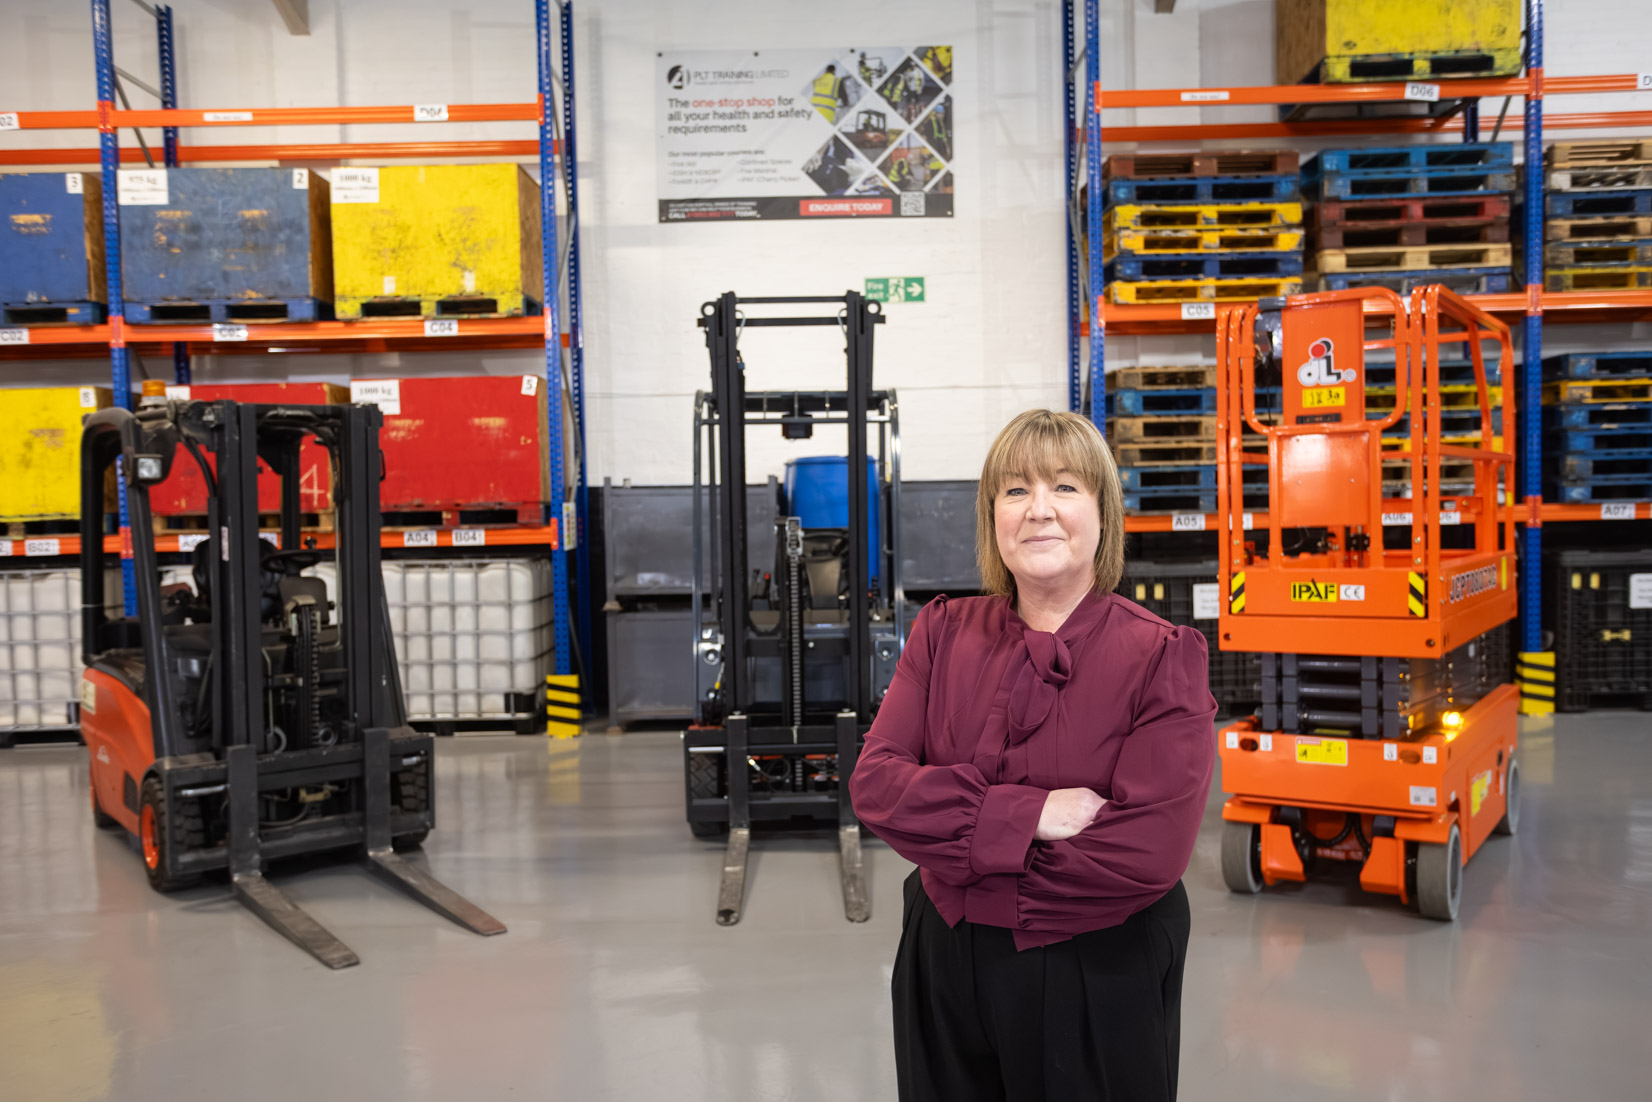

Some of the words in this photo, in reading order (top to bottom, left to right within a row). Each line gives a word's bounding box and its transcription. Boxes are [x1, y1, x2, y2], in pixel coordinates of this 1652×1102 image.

[713, 70, 755, 80] TRAINING
[1411, 84, 1435, 98] D06
[668, 98, 690, 109] The
[692, 97, 744, 110] one-stop
[746, 96, 776, 109] shop
[778, 95, 795, 107] for
[667, 110, 682, 122] all
[684, 112, 710, 123] your
[712, 109, 750, 121] health
[752, 109, 775, 120] and
[777, 107, 813, 121] safety
[667, 123, 747, 135] requirements
[70, 176, 79, 189] 3
[296, 172, 305, 184] 2
[808, 202, 850, 213] ENQUIRE
[852, 202, 884, 213] TODAY
[867, 281, 885, 291] Fire
[1186, 304, 1211, 317] C05
[429, 321, 454, 334] C04
[525, 379, 534, 391] 5
[299, 463, 326, 509] 4
[1174, 516, 1198, 528] A05
[406, 532, 429, 543] A04
[454, 530, 477, 542] B04
[1292, 578, 1336, 600] IPAF
